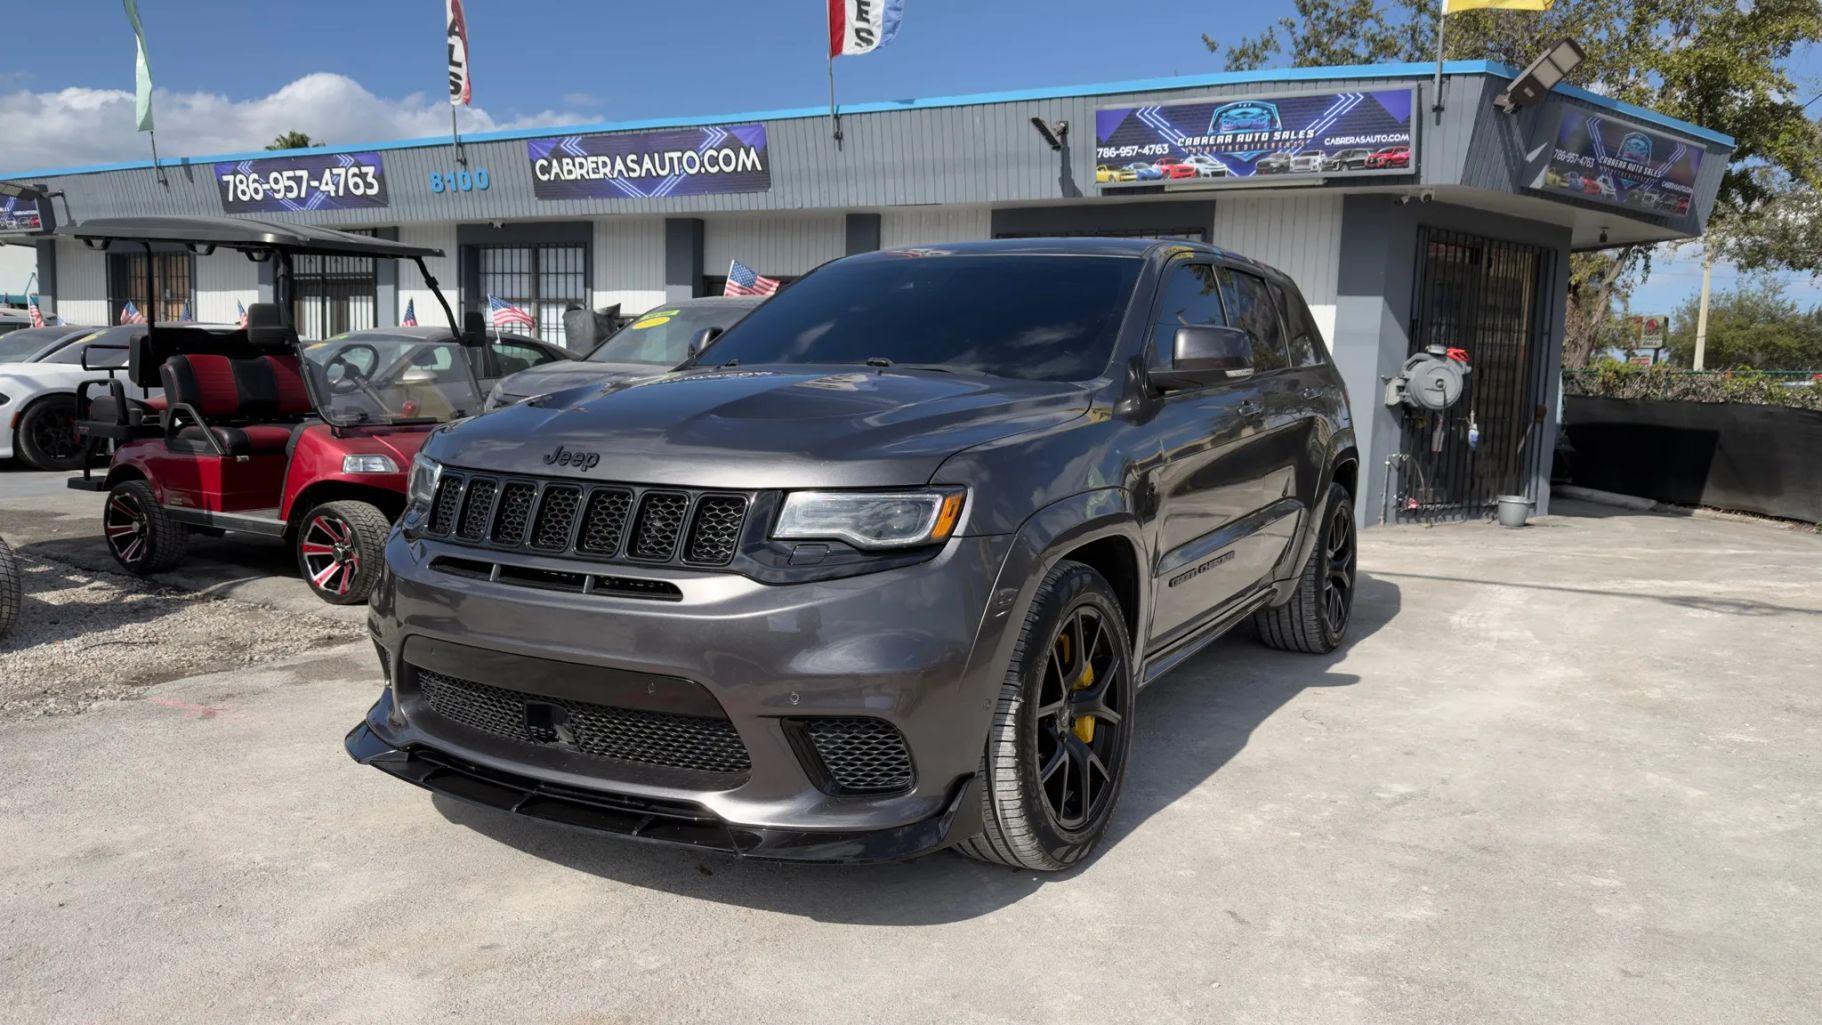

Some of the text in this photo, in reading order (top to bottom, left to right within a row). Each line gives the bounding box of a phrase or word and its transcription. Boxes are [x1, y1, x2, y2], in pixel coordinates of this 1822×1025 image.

[1177, 129, 1315, 146] CABRERA AUTO SALES
[1324, 133, 1410, 145] CABRERASAUTO.COM
[1096, 143, 1169, 158] 786-957-4763
[535, 147, 762, 181] CABRERASAUTO.COM
[222, 166, 379, 202] 786-957-4763
[430, 168, 490, 193] 8100
[543, 445, 600, 472] Jeep
